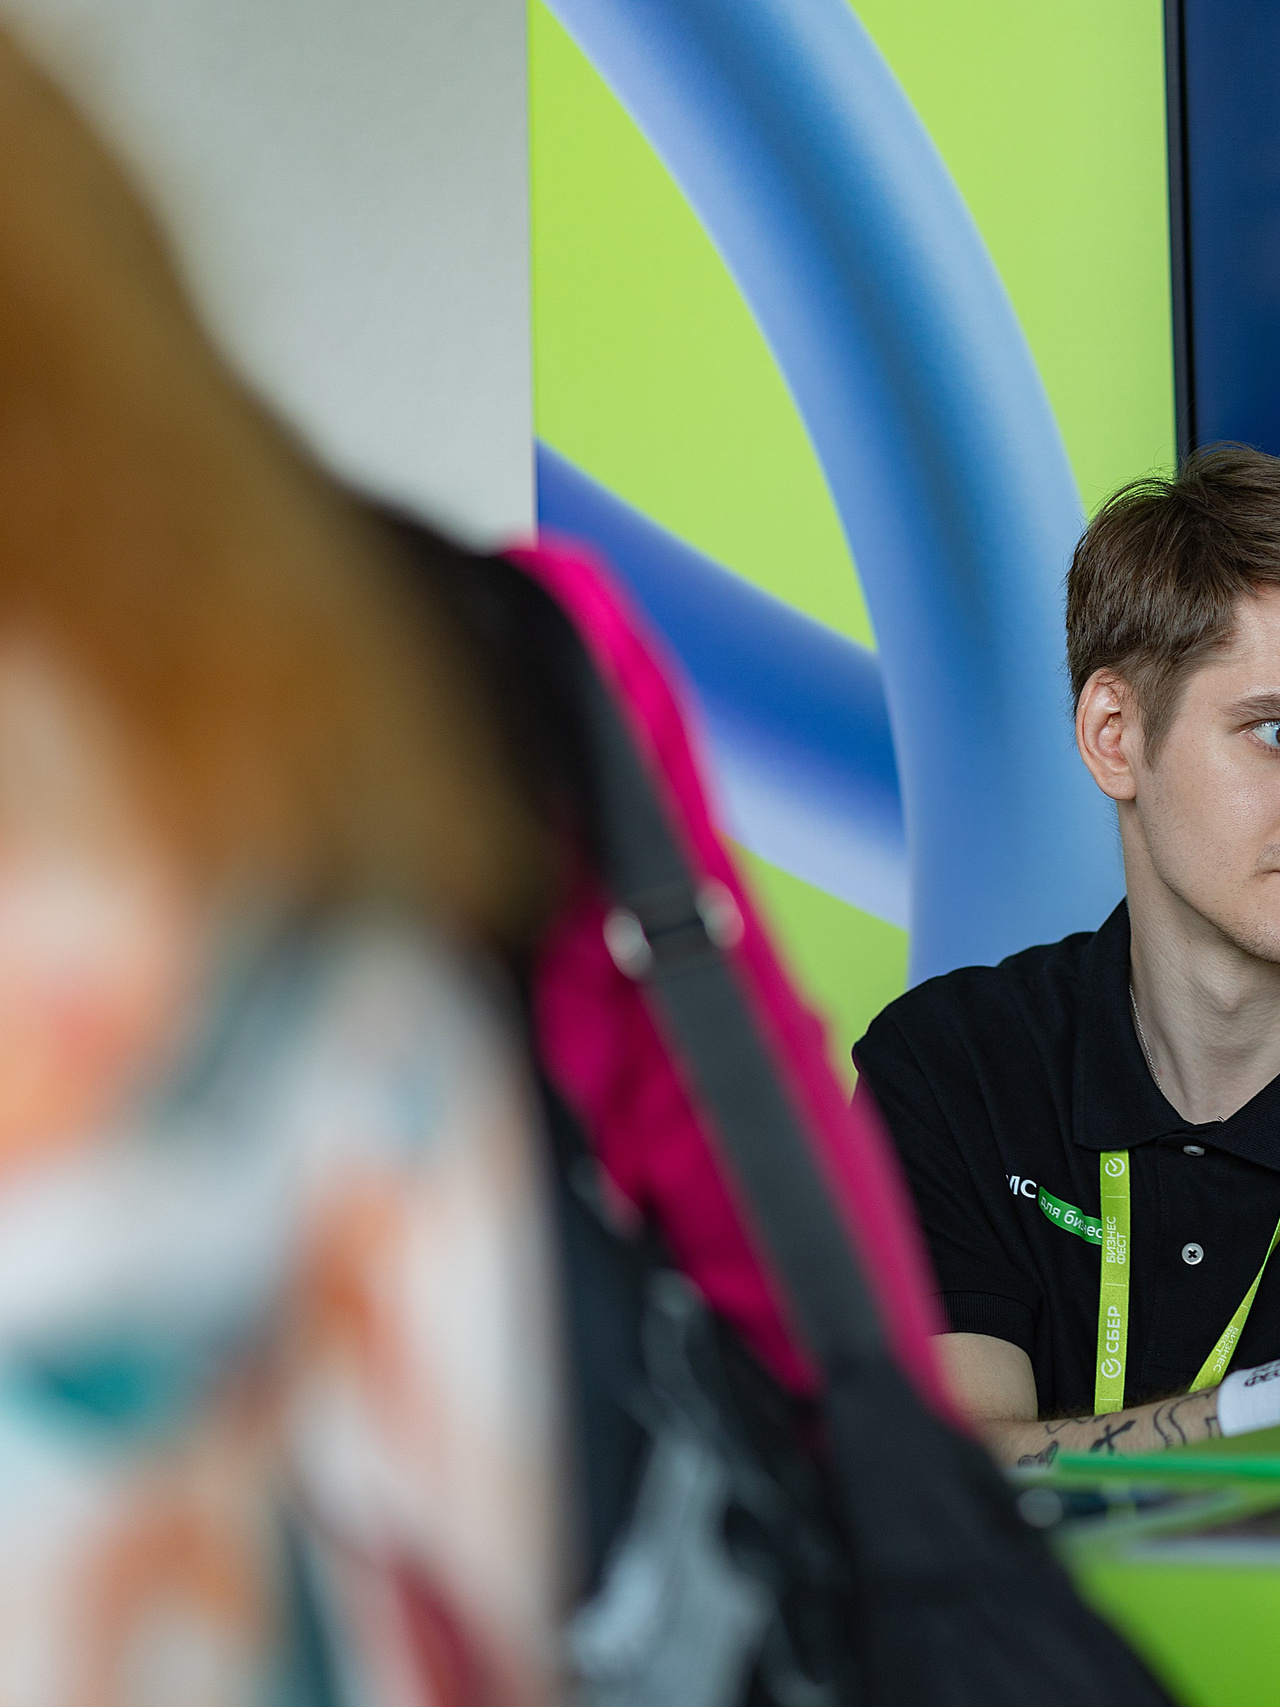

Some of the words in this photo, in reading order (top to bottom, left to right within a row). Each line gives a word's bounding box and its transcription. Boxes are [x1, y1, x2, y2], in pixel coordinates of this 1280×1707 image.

[1040, 1196, 1062, 1219] для
[1063, 1210, 1103, 1239] биес
[1106, 1215, 1117, 1264] БИЗНЕС
[1116, 1231, 1127, 1265] ФЕСТ
[1105, 1305, 1121, 1354] СБЕР
[1212, 1327, 1239, 1373] БИЗНЕС
